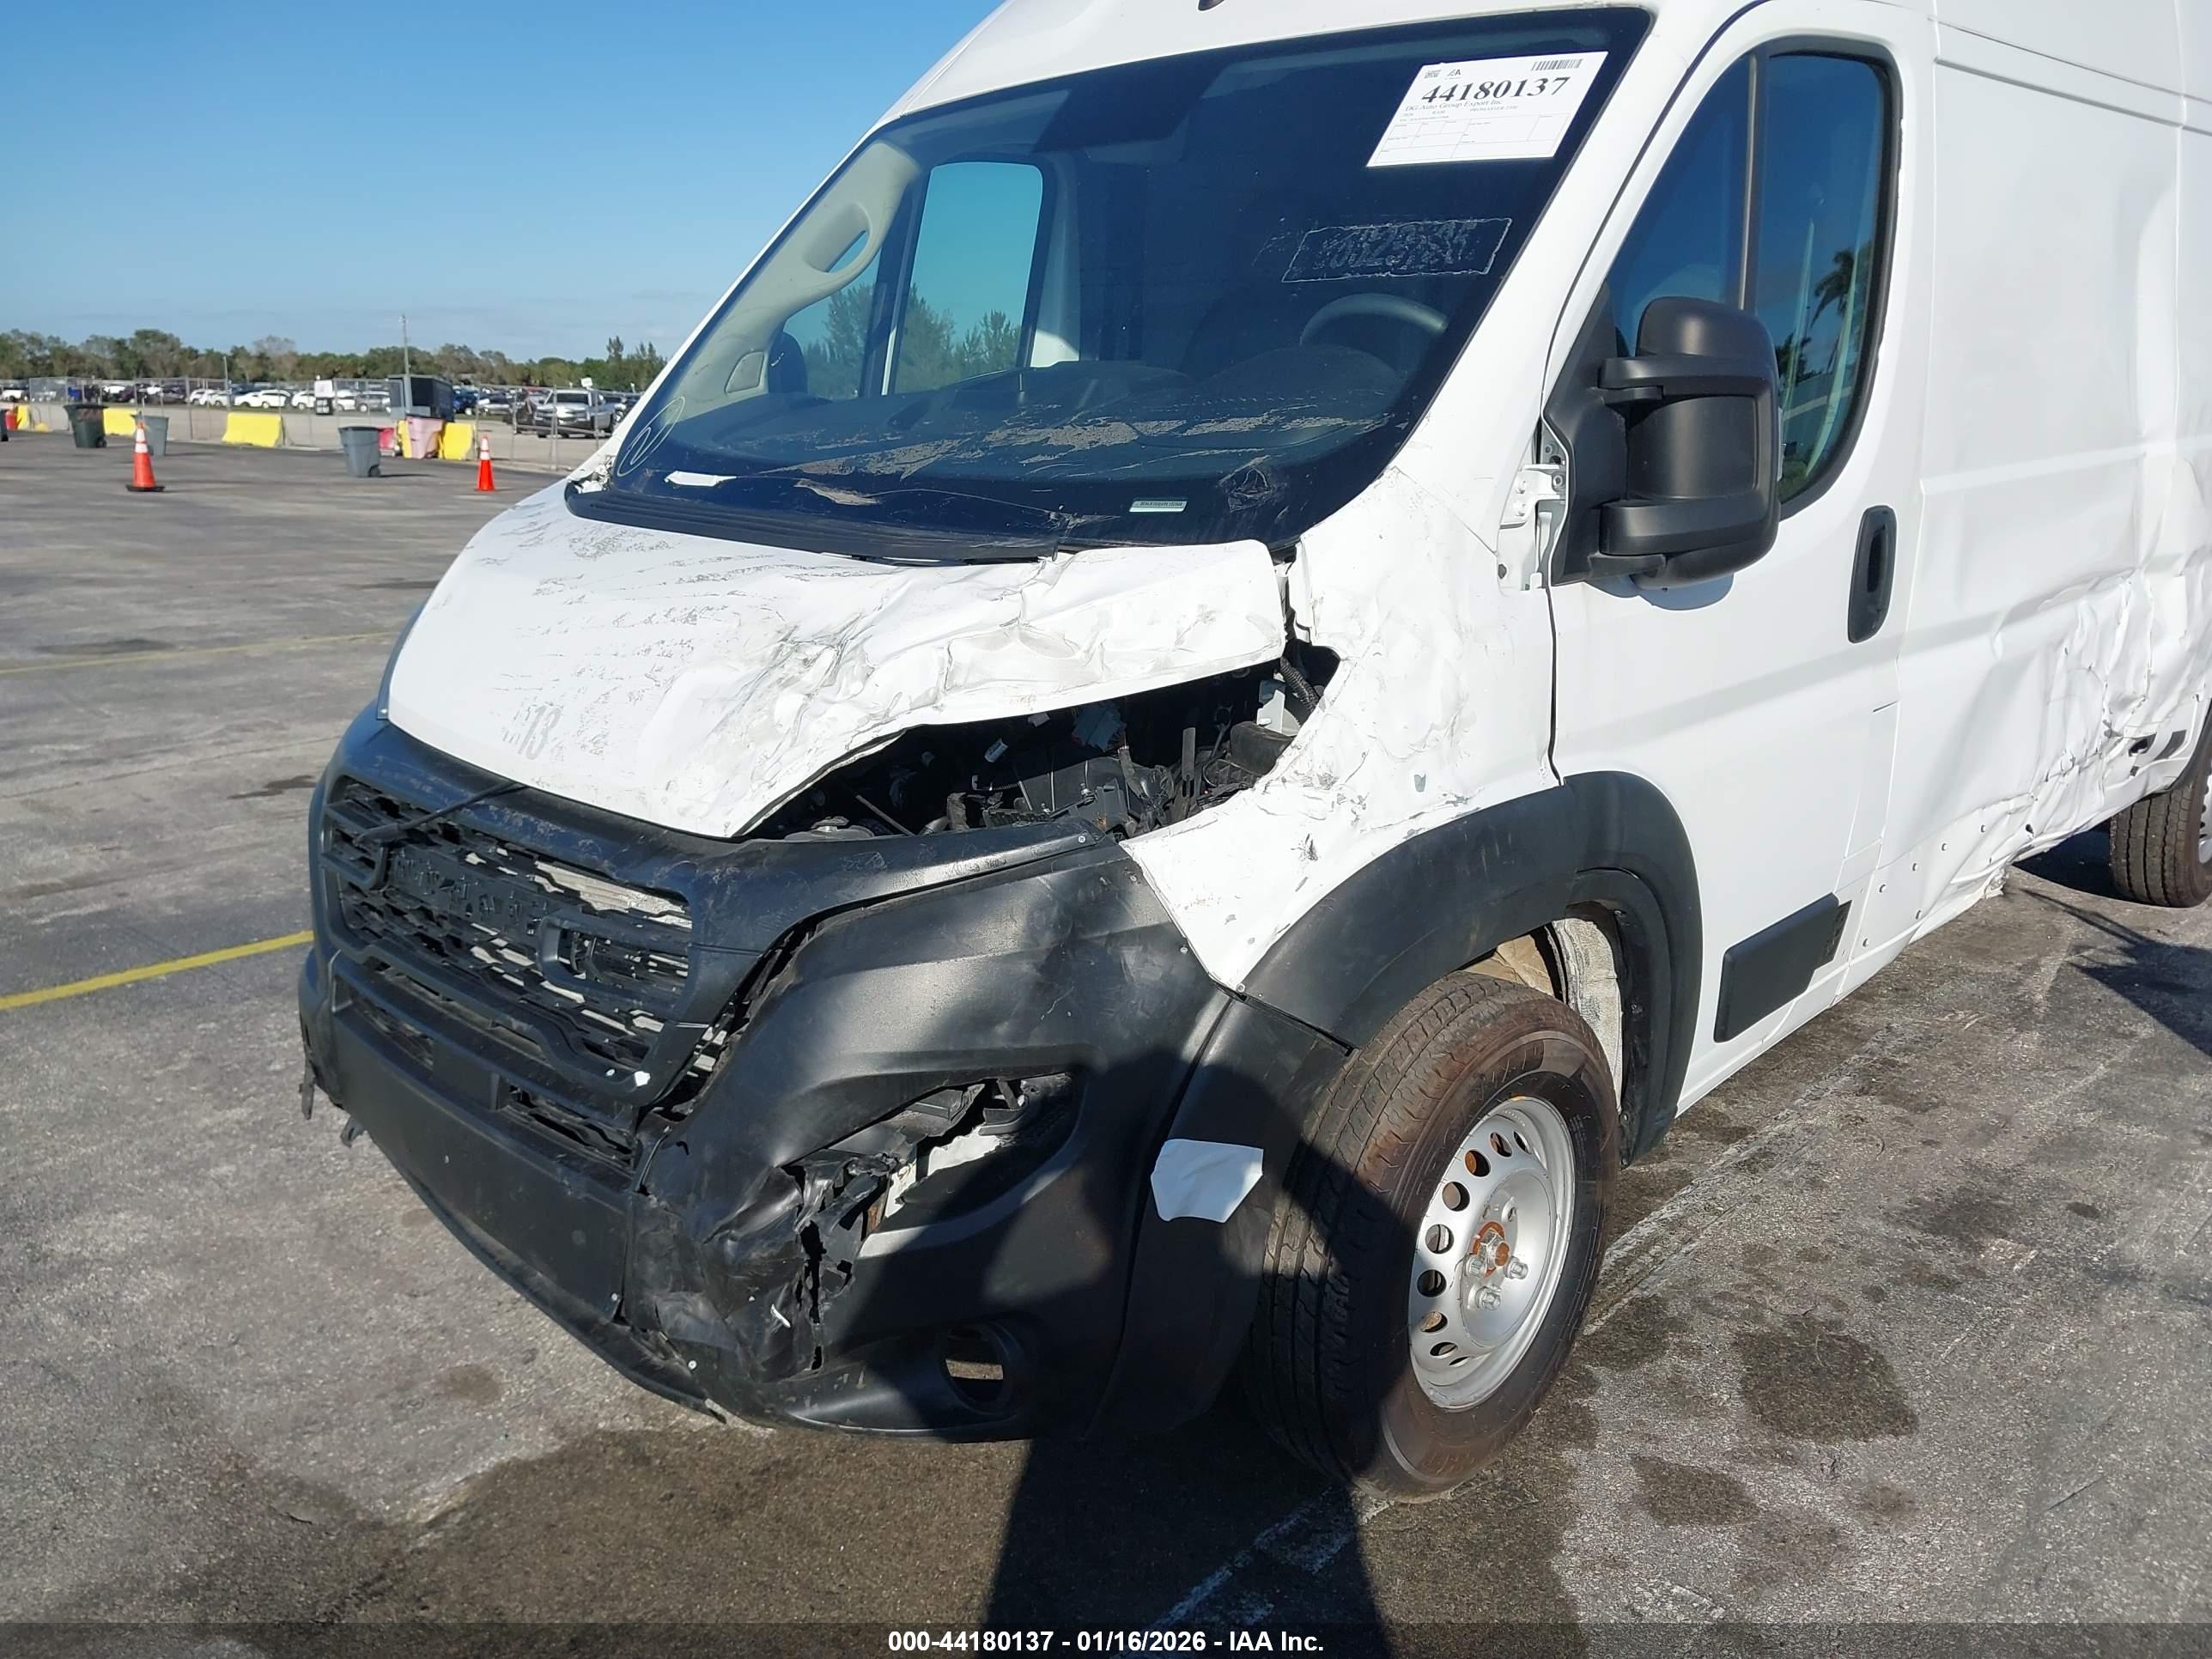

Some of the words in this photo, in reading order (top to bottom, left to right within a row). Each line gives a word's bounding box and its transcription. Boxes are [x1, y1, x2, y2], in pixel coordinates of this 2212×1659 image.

[1421, 76, 1571, 103] 44180137
[1421, 102, 1437, 111] Auto
[1438, 101, 1463, 110] Group
[1463, 100, 1490, 108] Export
